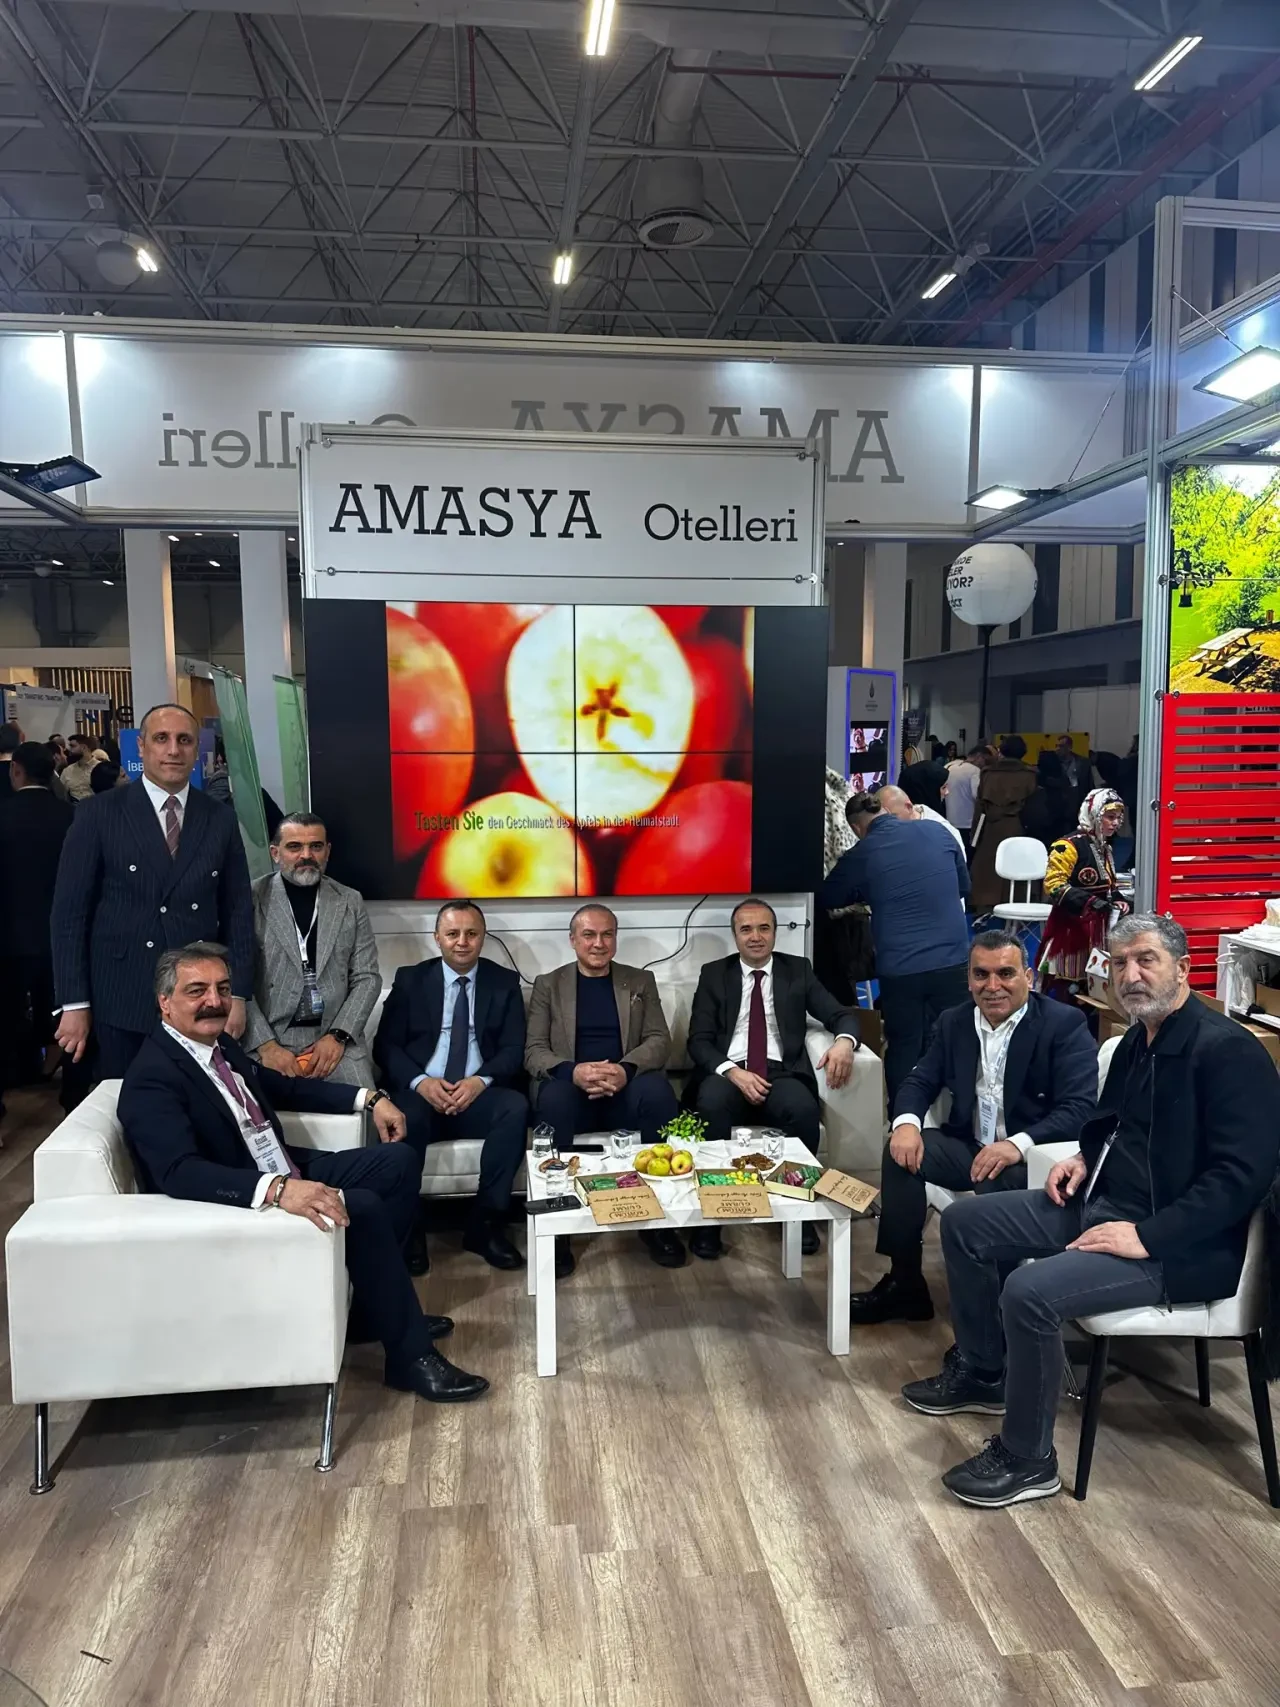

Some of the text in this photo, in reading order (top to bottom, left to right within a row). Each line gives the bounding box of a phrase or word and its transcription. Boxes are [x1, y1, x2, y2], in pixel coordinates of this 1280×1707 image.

[328, 483, 798, 542] AMASYA Otelleri
[414, 811, 459, 831] Tasten
[463, 810, 484, 831] Sie
[488, 816, 504, 829] den
[506, 815, 554, 829] Geschmack
[556, 816, 570, 829] des
[603, 815, 612, 828] in
[614, 815, 628, 828] der
[629, 815, 680, 828] Heimatstadt
